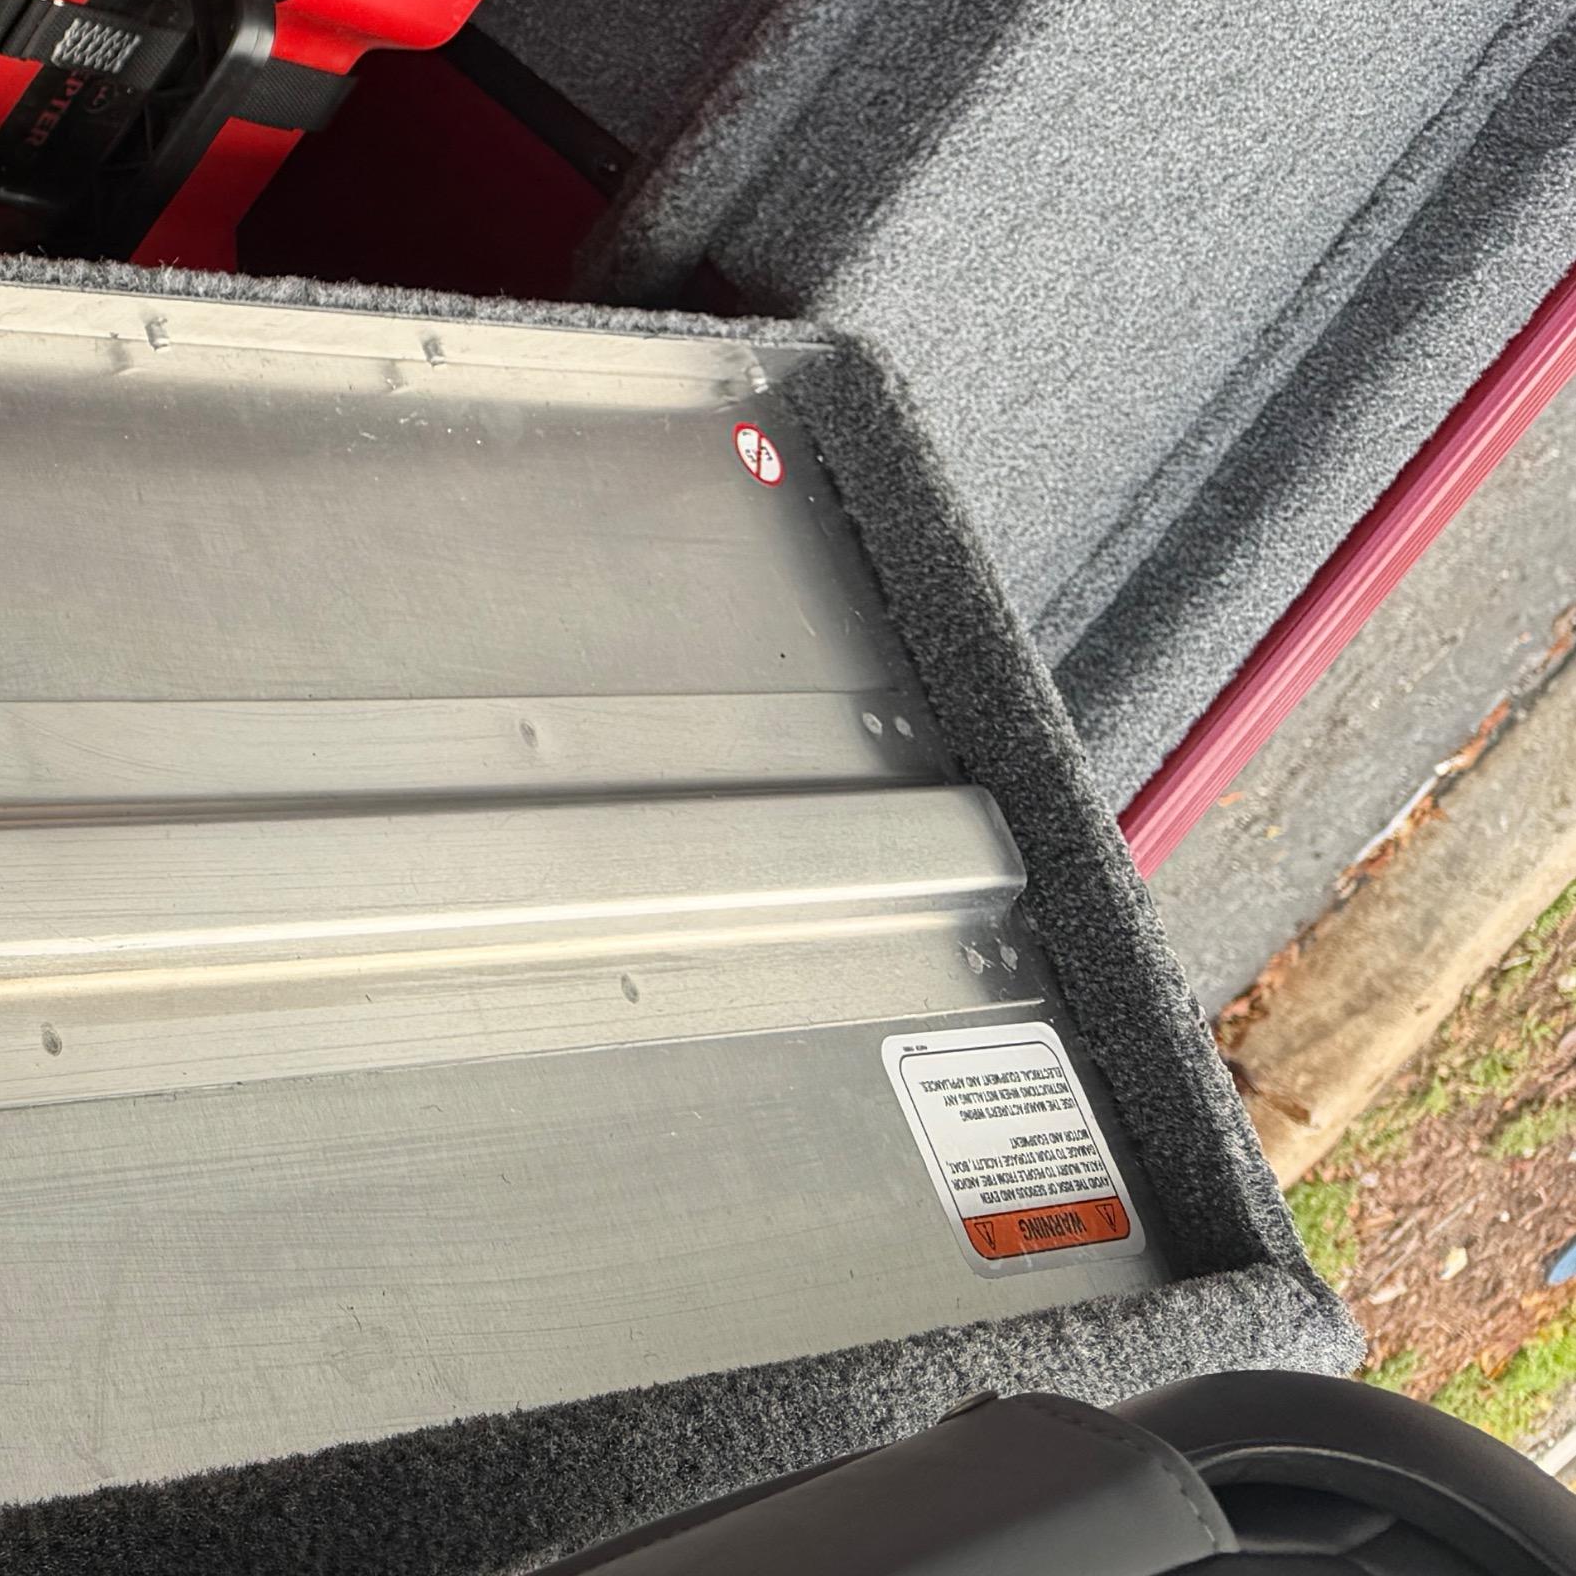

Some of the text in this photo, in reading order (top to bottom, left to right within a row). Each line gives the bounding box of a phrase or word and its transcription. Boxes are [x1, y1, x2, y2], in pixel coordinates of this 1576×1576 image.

[981, 1070, 1021, 1087] EQUIPMENT
[1021, 1066, 1062, 1082] ELECTRICAL
[966, 1076, 980, 1089] AND
[943, 1082, 1069, 1107] INSTRUCTIONS WHEN INSTALLING ANY
[1046, 1099, 1060, 1112] THE
[1060, 1098, 1074, 1111] USE
[959, 1109, 984, 1122] WIRING
[1009, 1128, 1089, 1149] MOTOR AND EQUIPMENT
[1002, 1151, 1035, 1167] STORAGE
[1036, 1149, 1055, 1162] YOUR
[1065, 1144, 1096, 1160] DAMAGE
[1055, 1163, 1080, 1177] INJURY
[1080, 1160, 1103, 1173] FATAL
[979, 1173, 997, 1187] FIRE
[997, 1171, 1017, 1184] FROM
[1017, 1167, 1044, 1181] PEOPLE
[1057, 1180, 1075, 1192] RISK
[1075, 1179, 1088, 1192] THE
[1088, 1176, 1109, 1190] AVOID
[980, 1190, 999, 1204] EVEN
[1000, 1188, 1015, 1200] AND
[1015, 1183, 1047, 1198] SERIOUS
[1018, 1210, 1087, 1240] WARNING
